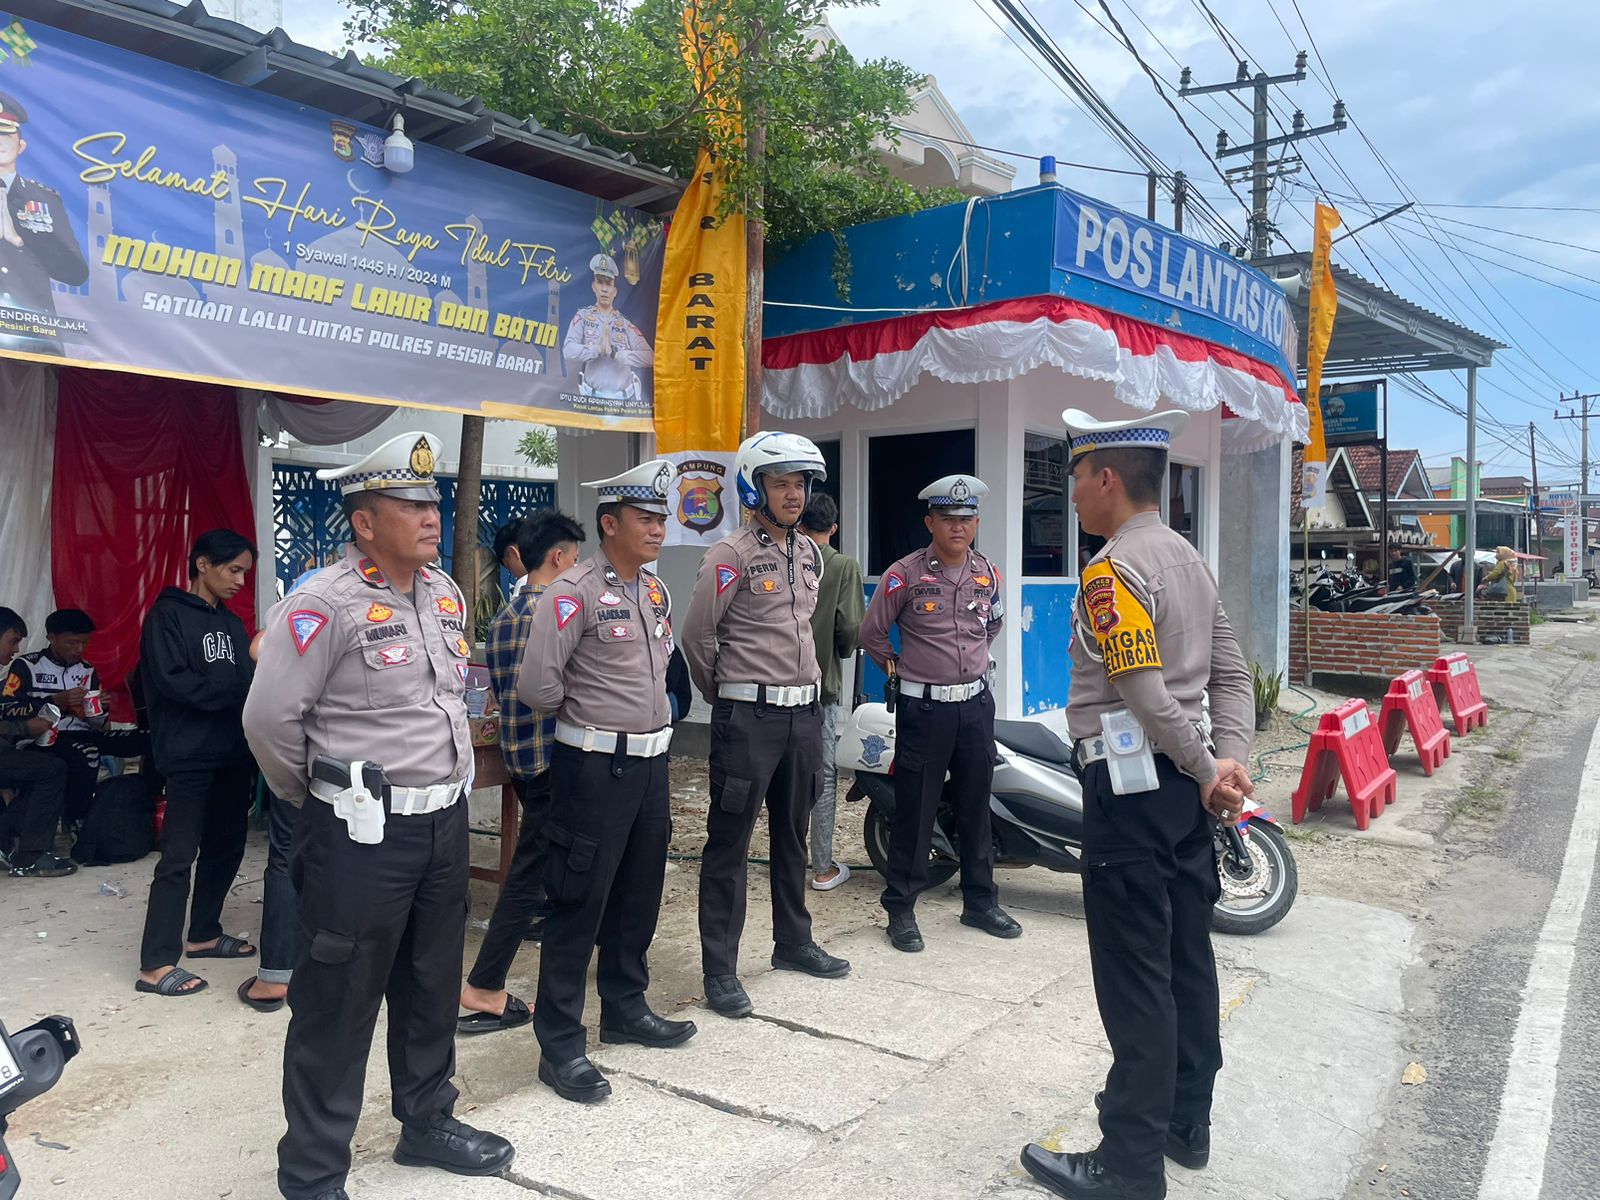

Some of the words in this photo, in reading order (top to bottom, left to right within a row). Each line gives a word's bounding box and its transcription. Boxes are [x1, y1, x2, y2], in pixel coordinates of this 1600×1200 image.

[73, 132, 229, 199] Selamat
[243, 177, 347, 232] Hari
[351, 197, 439, 262] Raya
[445, 224, 510, 265] Idul
[512, 243, 571, 285] Fitri
[102, 233, 241, 287] MOHON
[249, 262, 345, 305] MAAF
[351, 283, 434, 323] LAHIR
[438, 302, 489, 335] DAN
[493, 312, 559, 348] BATIN
[283, 241, 290, 254] 1
[296, 243, 347, 268] Syawal
[351, 256, 384, 275] 1445
[387, 263, 397, 277] H
[408, 267, 437, 287] 2024
[440, 276, 451, 289] M
[1075, 204, 1154, 289] POS
[1159, 237, 1261, 333] LANTAS
[0, 321, 31, 332] Pesisir
[32, 325, 57, 337] Barat
[142, 291, 233, 323] SATUAN
[238, 308, 291, 333] LALU
[297, 316, 363, 345] LINTAS
[367, 329, 433, 356] POLRES
[436, 343, 494, 367] PESISIR
[496, 352, 543, 375] BARAT
[685, 272, 715, 370] BARAT
[677, 462, 723, 474] LAMPUNG
[749, 562, 778, 575] PERDI
[1, 1065, 12, 1079] 8
